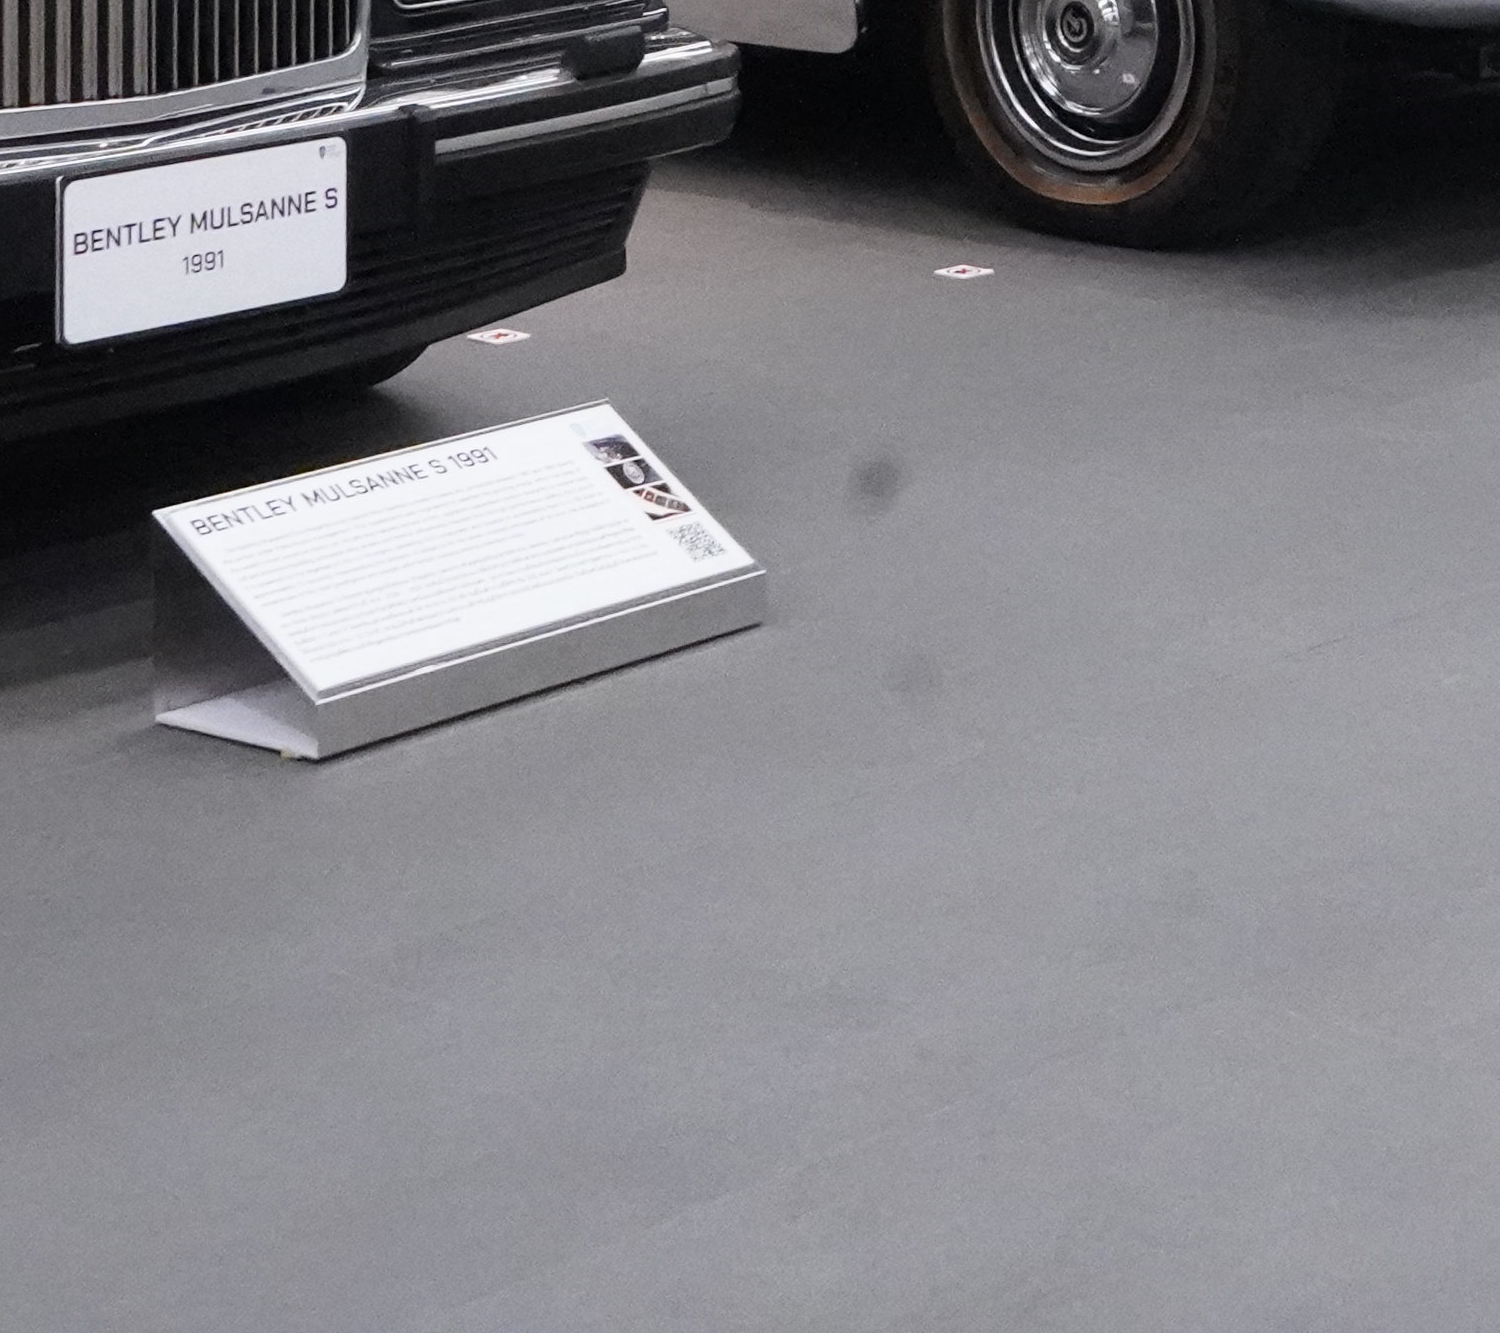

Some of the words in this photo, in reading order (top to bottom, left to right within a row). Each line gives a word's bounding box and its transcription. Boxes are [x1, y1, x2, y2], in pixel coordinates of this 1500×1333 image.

[72, 214, 182, 256] BENTLEY
[189, 190, 318, 235] MULSANNE
[324, 187, 339, 209] S
[182, 249, 225, 276] 1991
[190, 495, 299, 537] BENTLEY
[300, 462, 429, 509] MULSANNE
[430, 457, 449, 476] S
[447, 445, 499, 473] 1991
